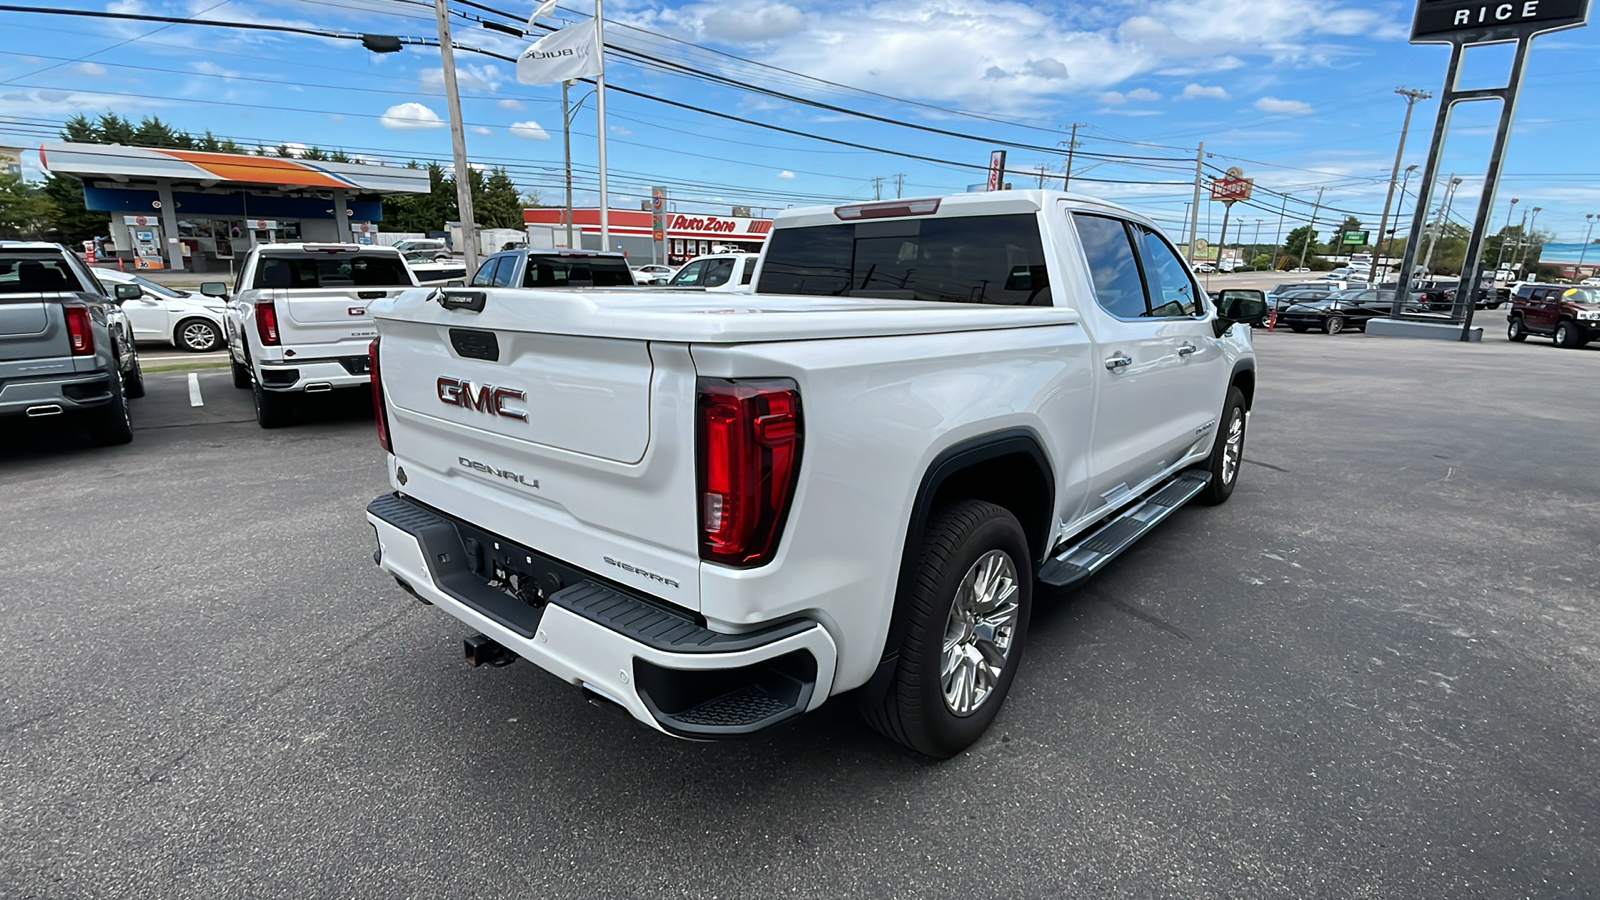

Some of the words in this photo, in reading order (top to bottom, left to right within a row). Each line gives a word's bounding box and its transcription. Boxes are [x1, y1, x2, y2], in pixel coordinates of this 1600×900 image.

[1454, 1, 1539, 25] RICE
[437, 375, 529, 424] GMC
[458, 456, 540, 489] DENALI
[603, 555, 680, 588] SIERRA
